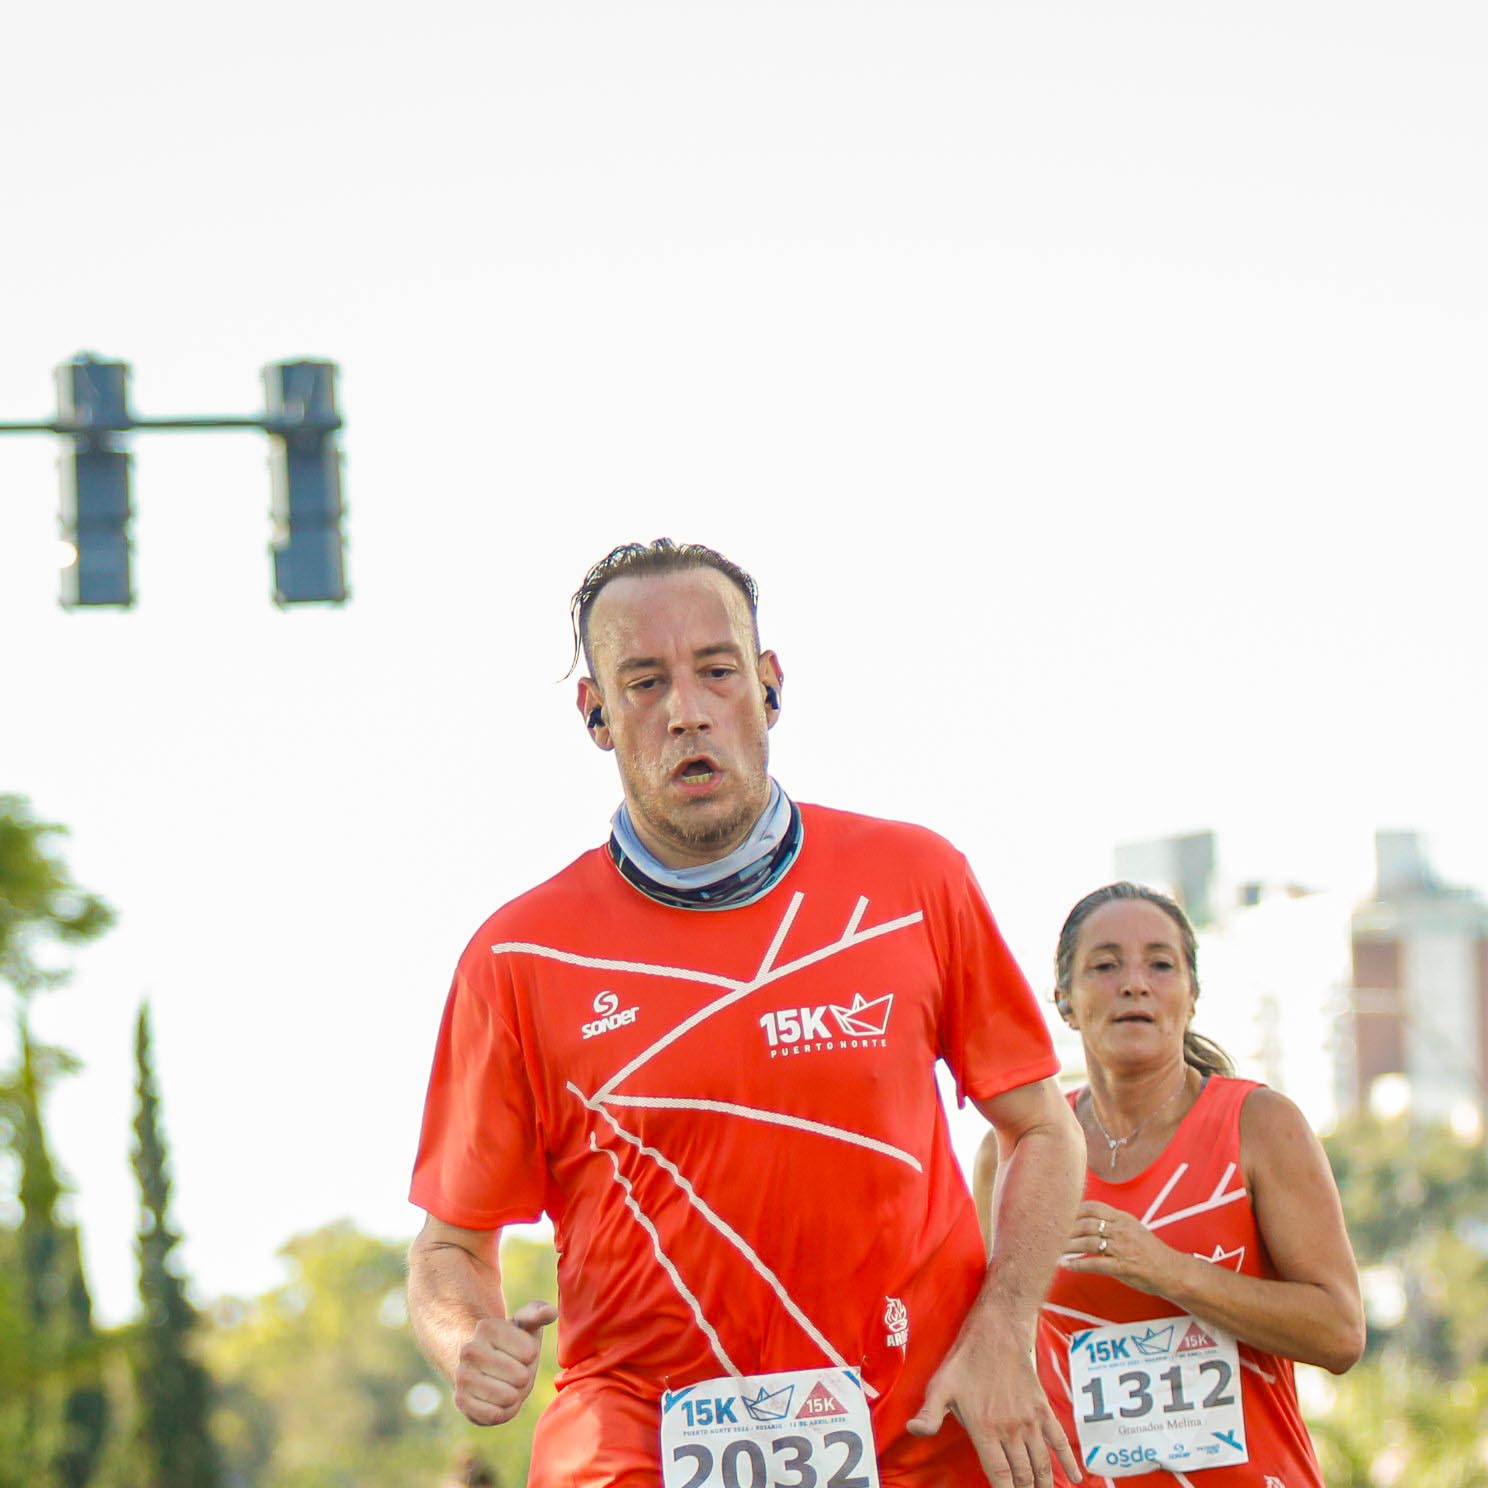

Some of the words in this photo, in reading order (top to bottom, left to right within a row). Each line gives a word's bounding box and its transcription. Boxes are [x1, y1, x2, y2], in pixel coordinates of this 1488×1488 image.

[759, 1005, 832, 1046] 15K
[770, 1042, 833, 1059] PUERTO
[840, 1039, 887, 1049] NORTE
[1085, 1336, 1131, 1363] 15K
[1184, 1333, 1208, 1348] 15K
[1081, 1359, 1235, 1424] 1312
[681, 1397, 738, 1427] 15K
[806, 1396, 836, 1413] 15K
[1117, 1422, 1164, 1436] Granados
[1167, 1418, 1202, 1431] Melina
[1105, 1445, 1157, 1466] osde
